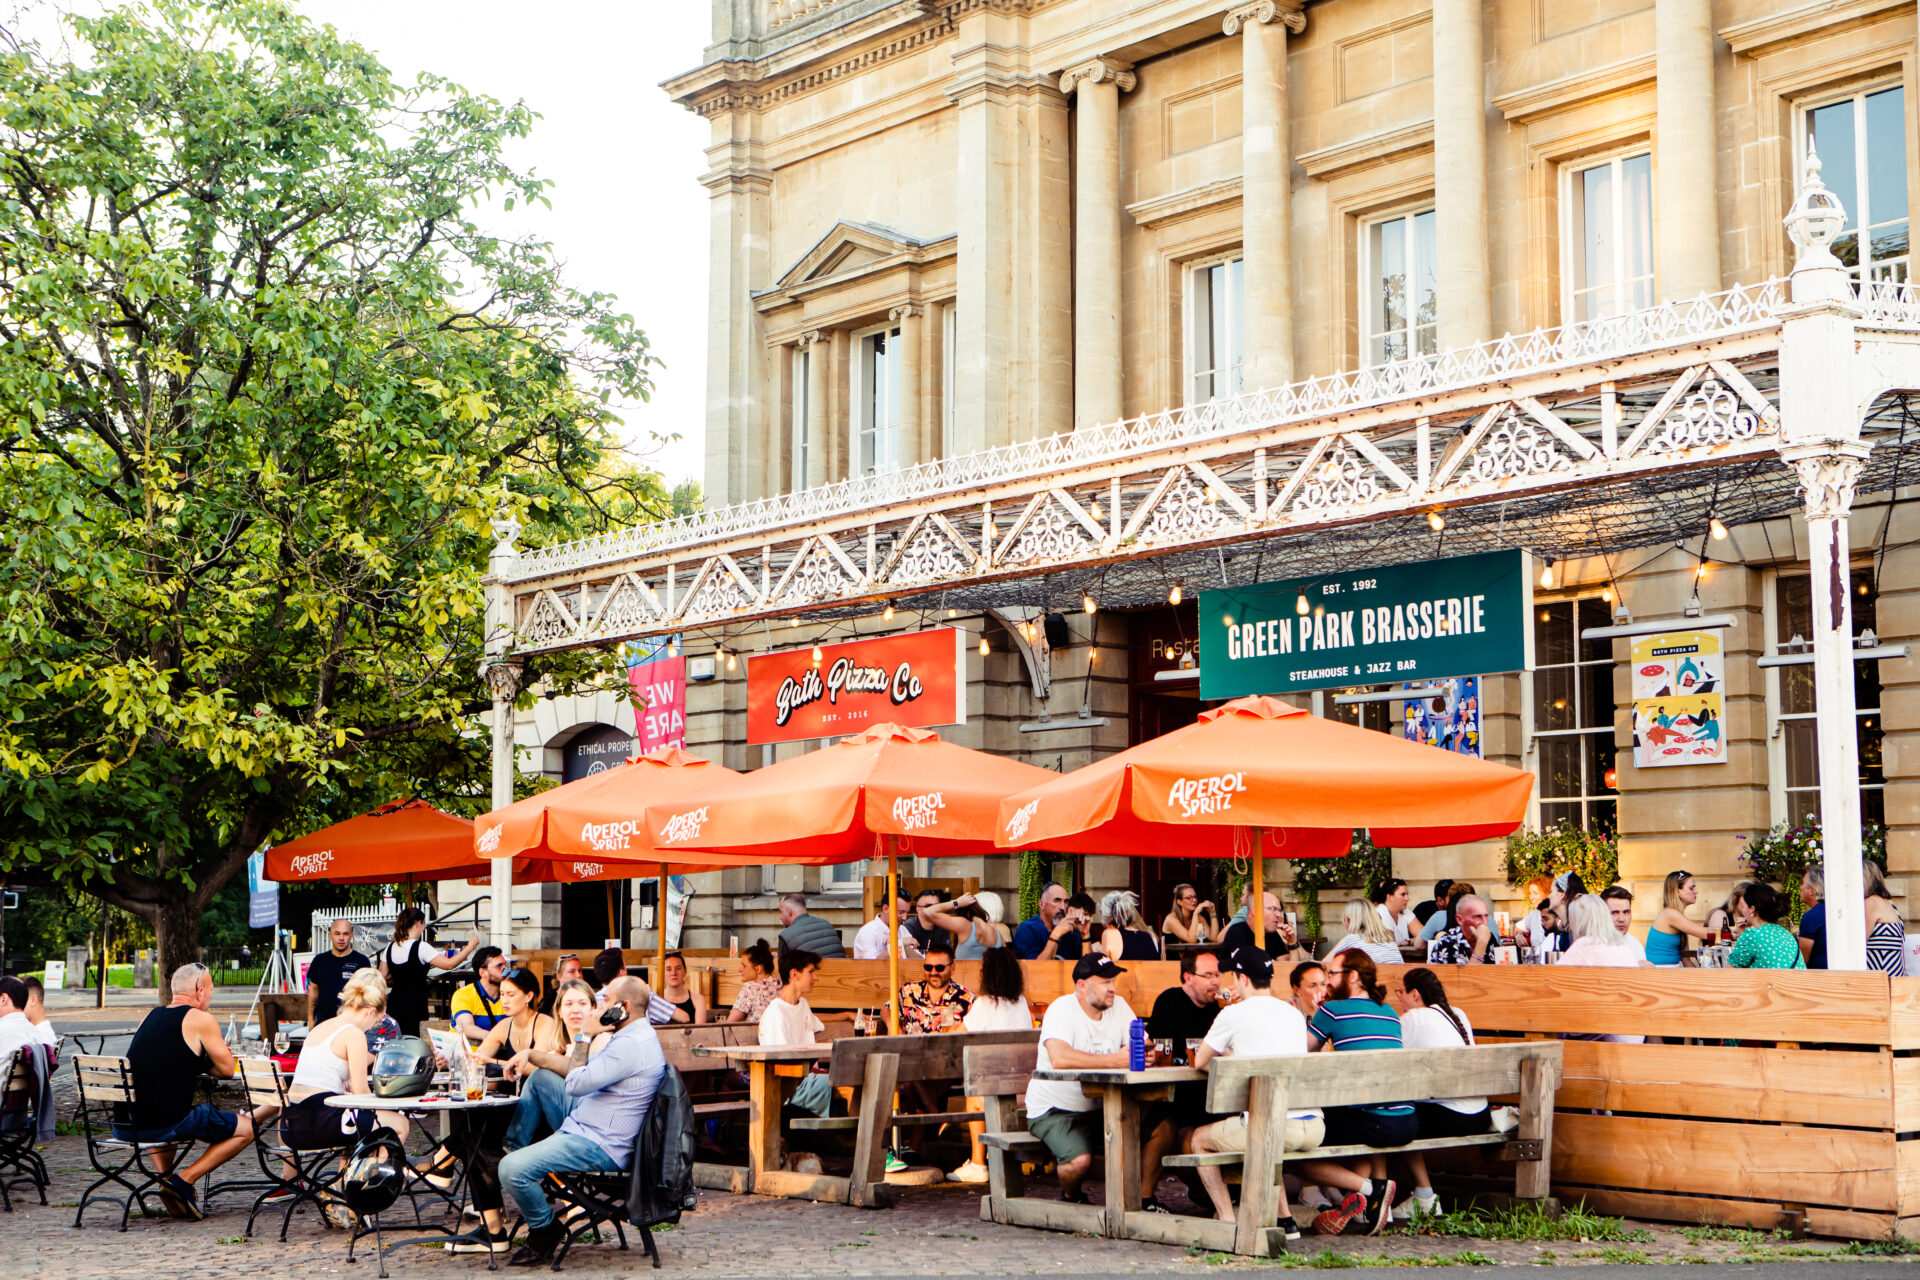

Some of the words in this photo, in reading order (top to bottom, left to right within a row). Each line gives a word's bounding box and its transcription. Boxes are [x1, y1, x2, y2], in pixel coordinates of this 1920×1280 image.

[1323, 583, 1346, 595] EST.
[1352, 579, 1377, 592] 1992
[1228, 619, 1292, 660] GREEN
[1299, 609, 1354, 652] PARK
[1362, 595, 1485, 643] BRASSERIE
[1289, 667, 1348, 681] STEAKHOUSE
[1354, 665, 1361, 675] &
[1366, 661, 1391, 674] JAZZ
[1396, 660, 1416, 671] BAR
[776, 669, 823, 726] Bath
[827, 657, 889, 703] Pizza
[892, 662, 923, 703] Co
[848, 710, 868, 720] 2016
[578, 743, 607, 756] ETHICAL
[1168, 772, 1247, 806] APEROL
[893, 791, 946, 820] APEROL
[581, 820, 641, 842] APEROL
[659, 806, 710, 836] APEROL
[290, 850, 334, 871] APEROL
